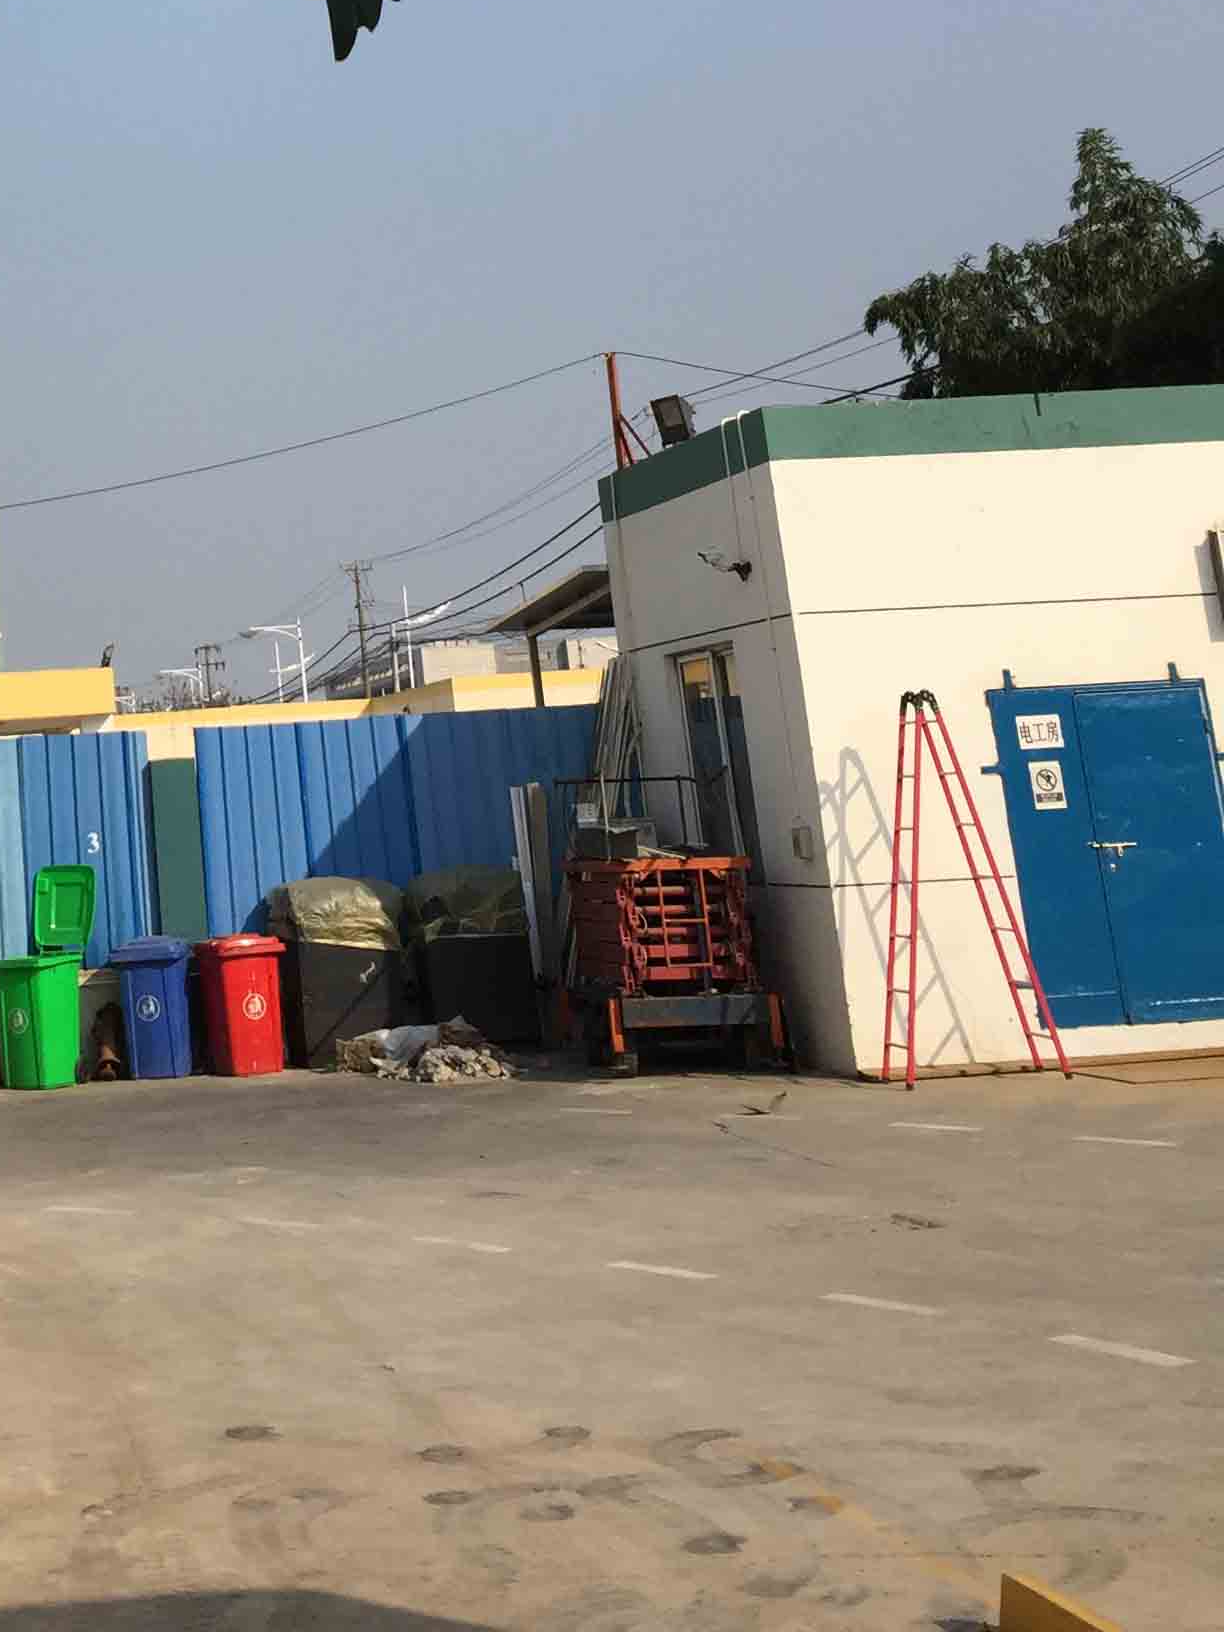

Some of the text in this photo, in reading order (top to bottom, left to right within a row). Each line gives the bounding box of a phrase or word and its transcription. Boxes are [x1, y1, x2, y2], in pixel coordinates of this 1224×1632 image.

[1019, 721, 1060, 744] 电工房
[87, 832, 100, 854] 3
